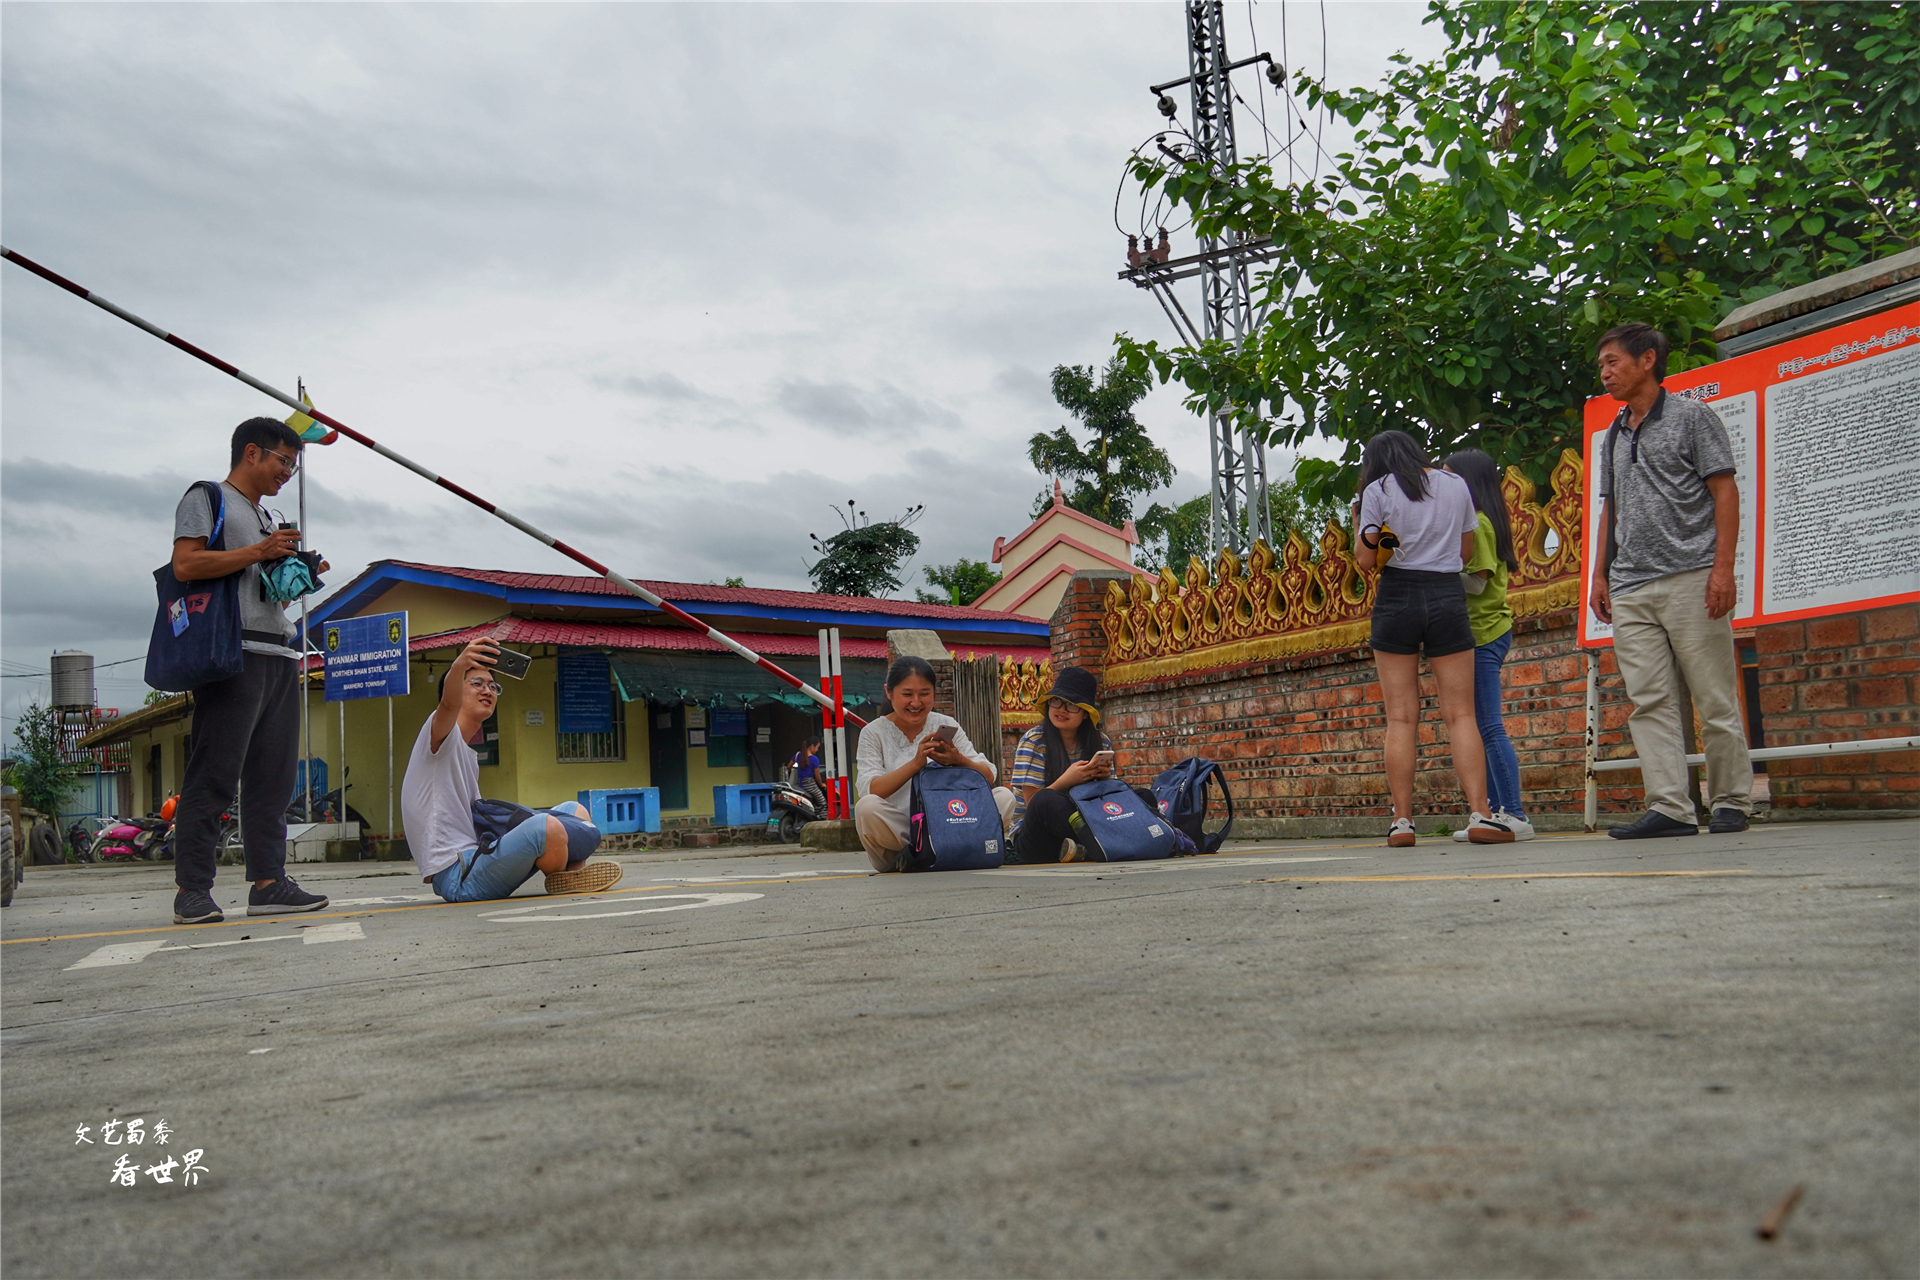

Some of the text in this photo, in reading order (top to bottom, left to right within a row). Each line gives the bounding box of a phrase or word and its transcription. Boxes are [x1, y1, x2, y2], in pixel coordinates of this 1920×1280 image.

[328, 648, 402, 666] MYANMAR IMMIGRATION
[331, 664, 398, 678] NORTHEN SHAN STATE, MUSE
[365, 680, 387, 688] TOWNSHIP
